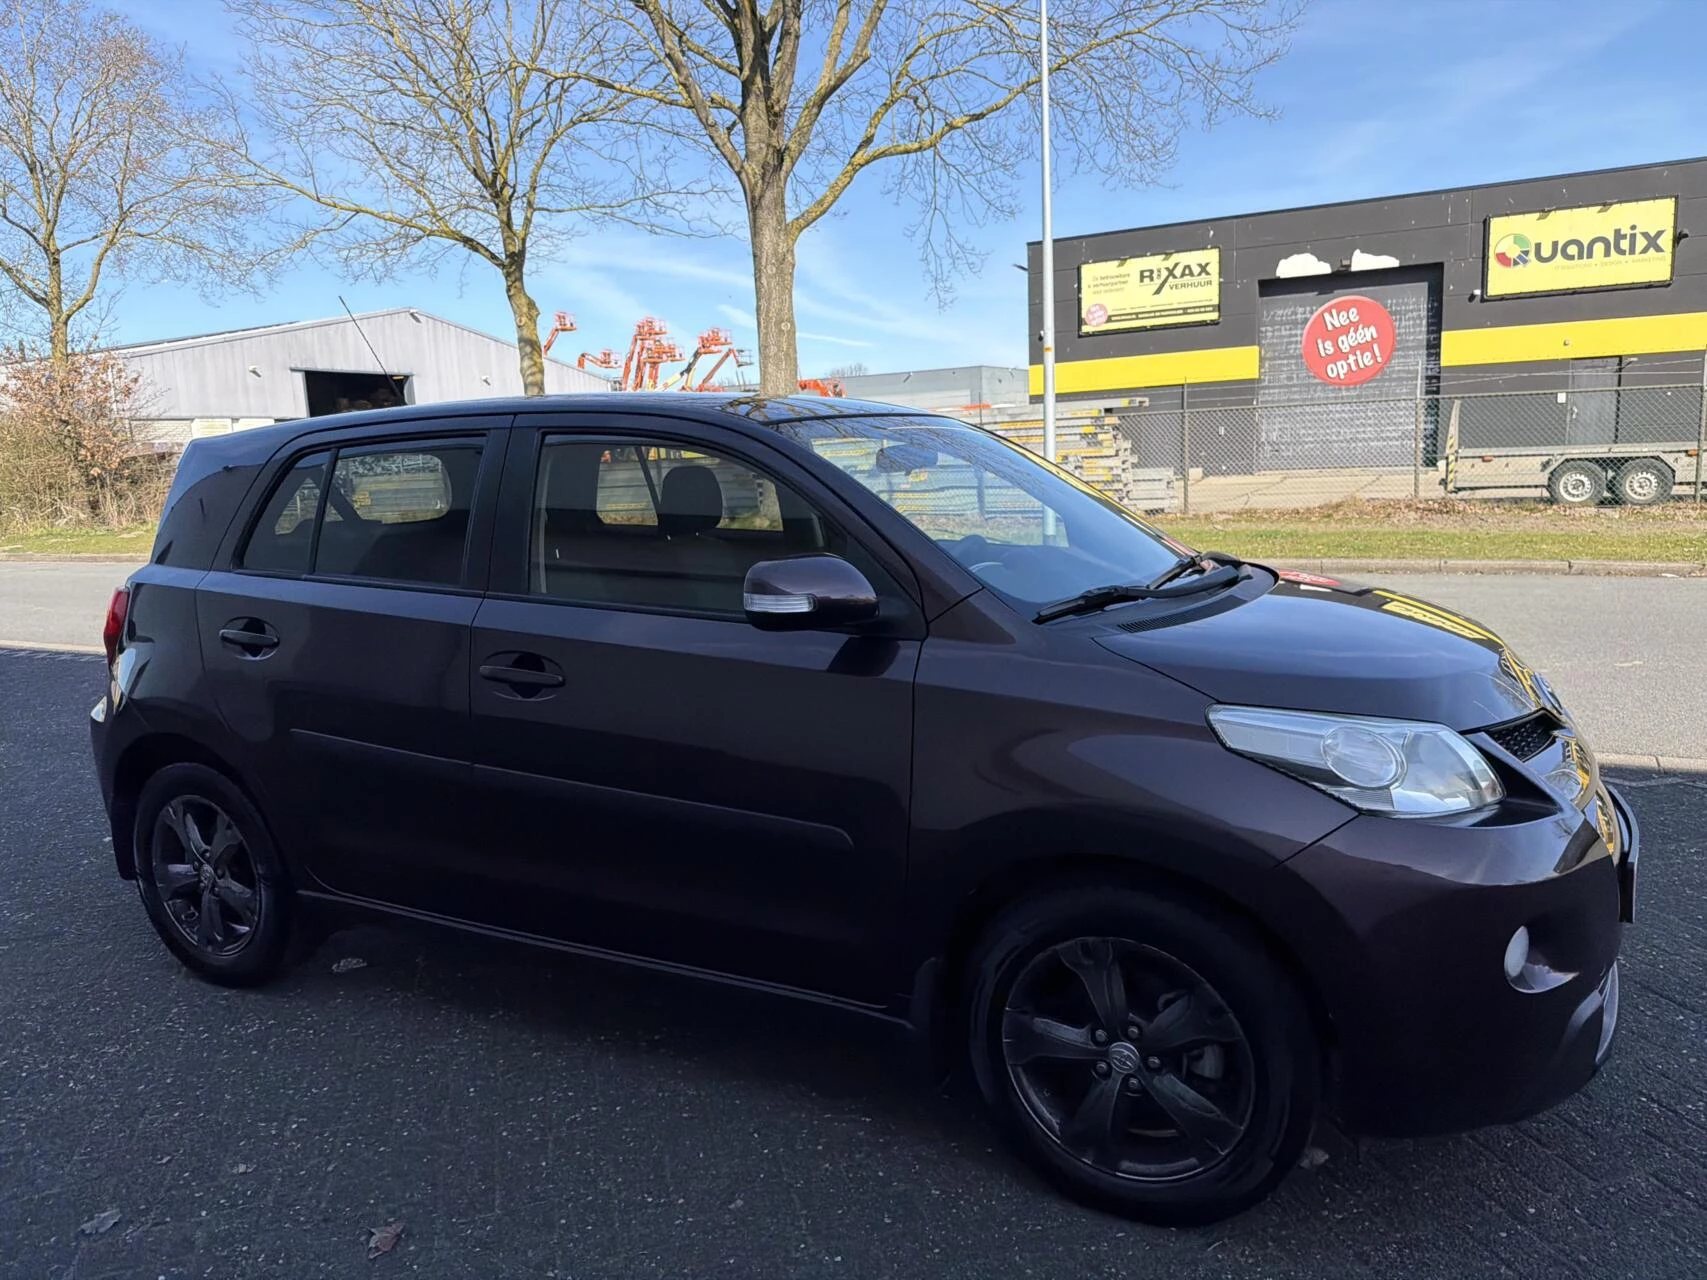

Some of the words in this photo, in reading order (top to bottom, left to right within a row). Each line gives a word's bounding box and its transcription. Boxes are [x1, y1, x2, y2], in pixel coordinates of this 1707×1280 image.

[1494, 224, 1666, 269] Quantix
[1168, 279, 1213, 291] VERHUUR
[1323, 307, 1360, 331] Nee
[1337, 325, 1378, 353] géén
